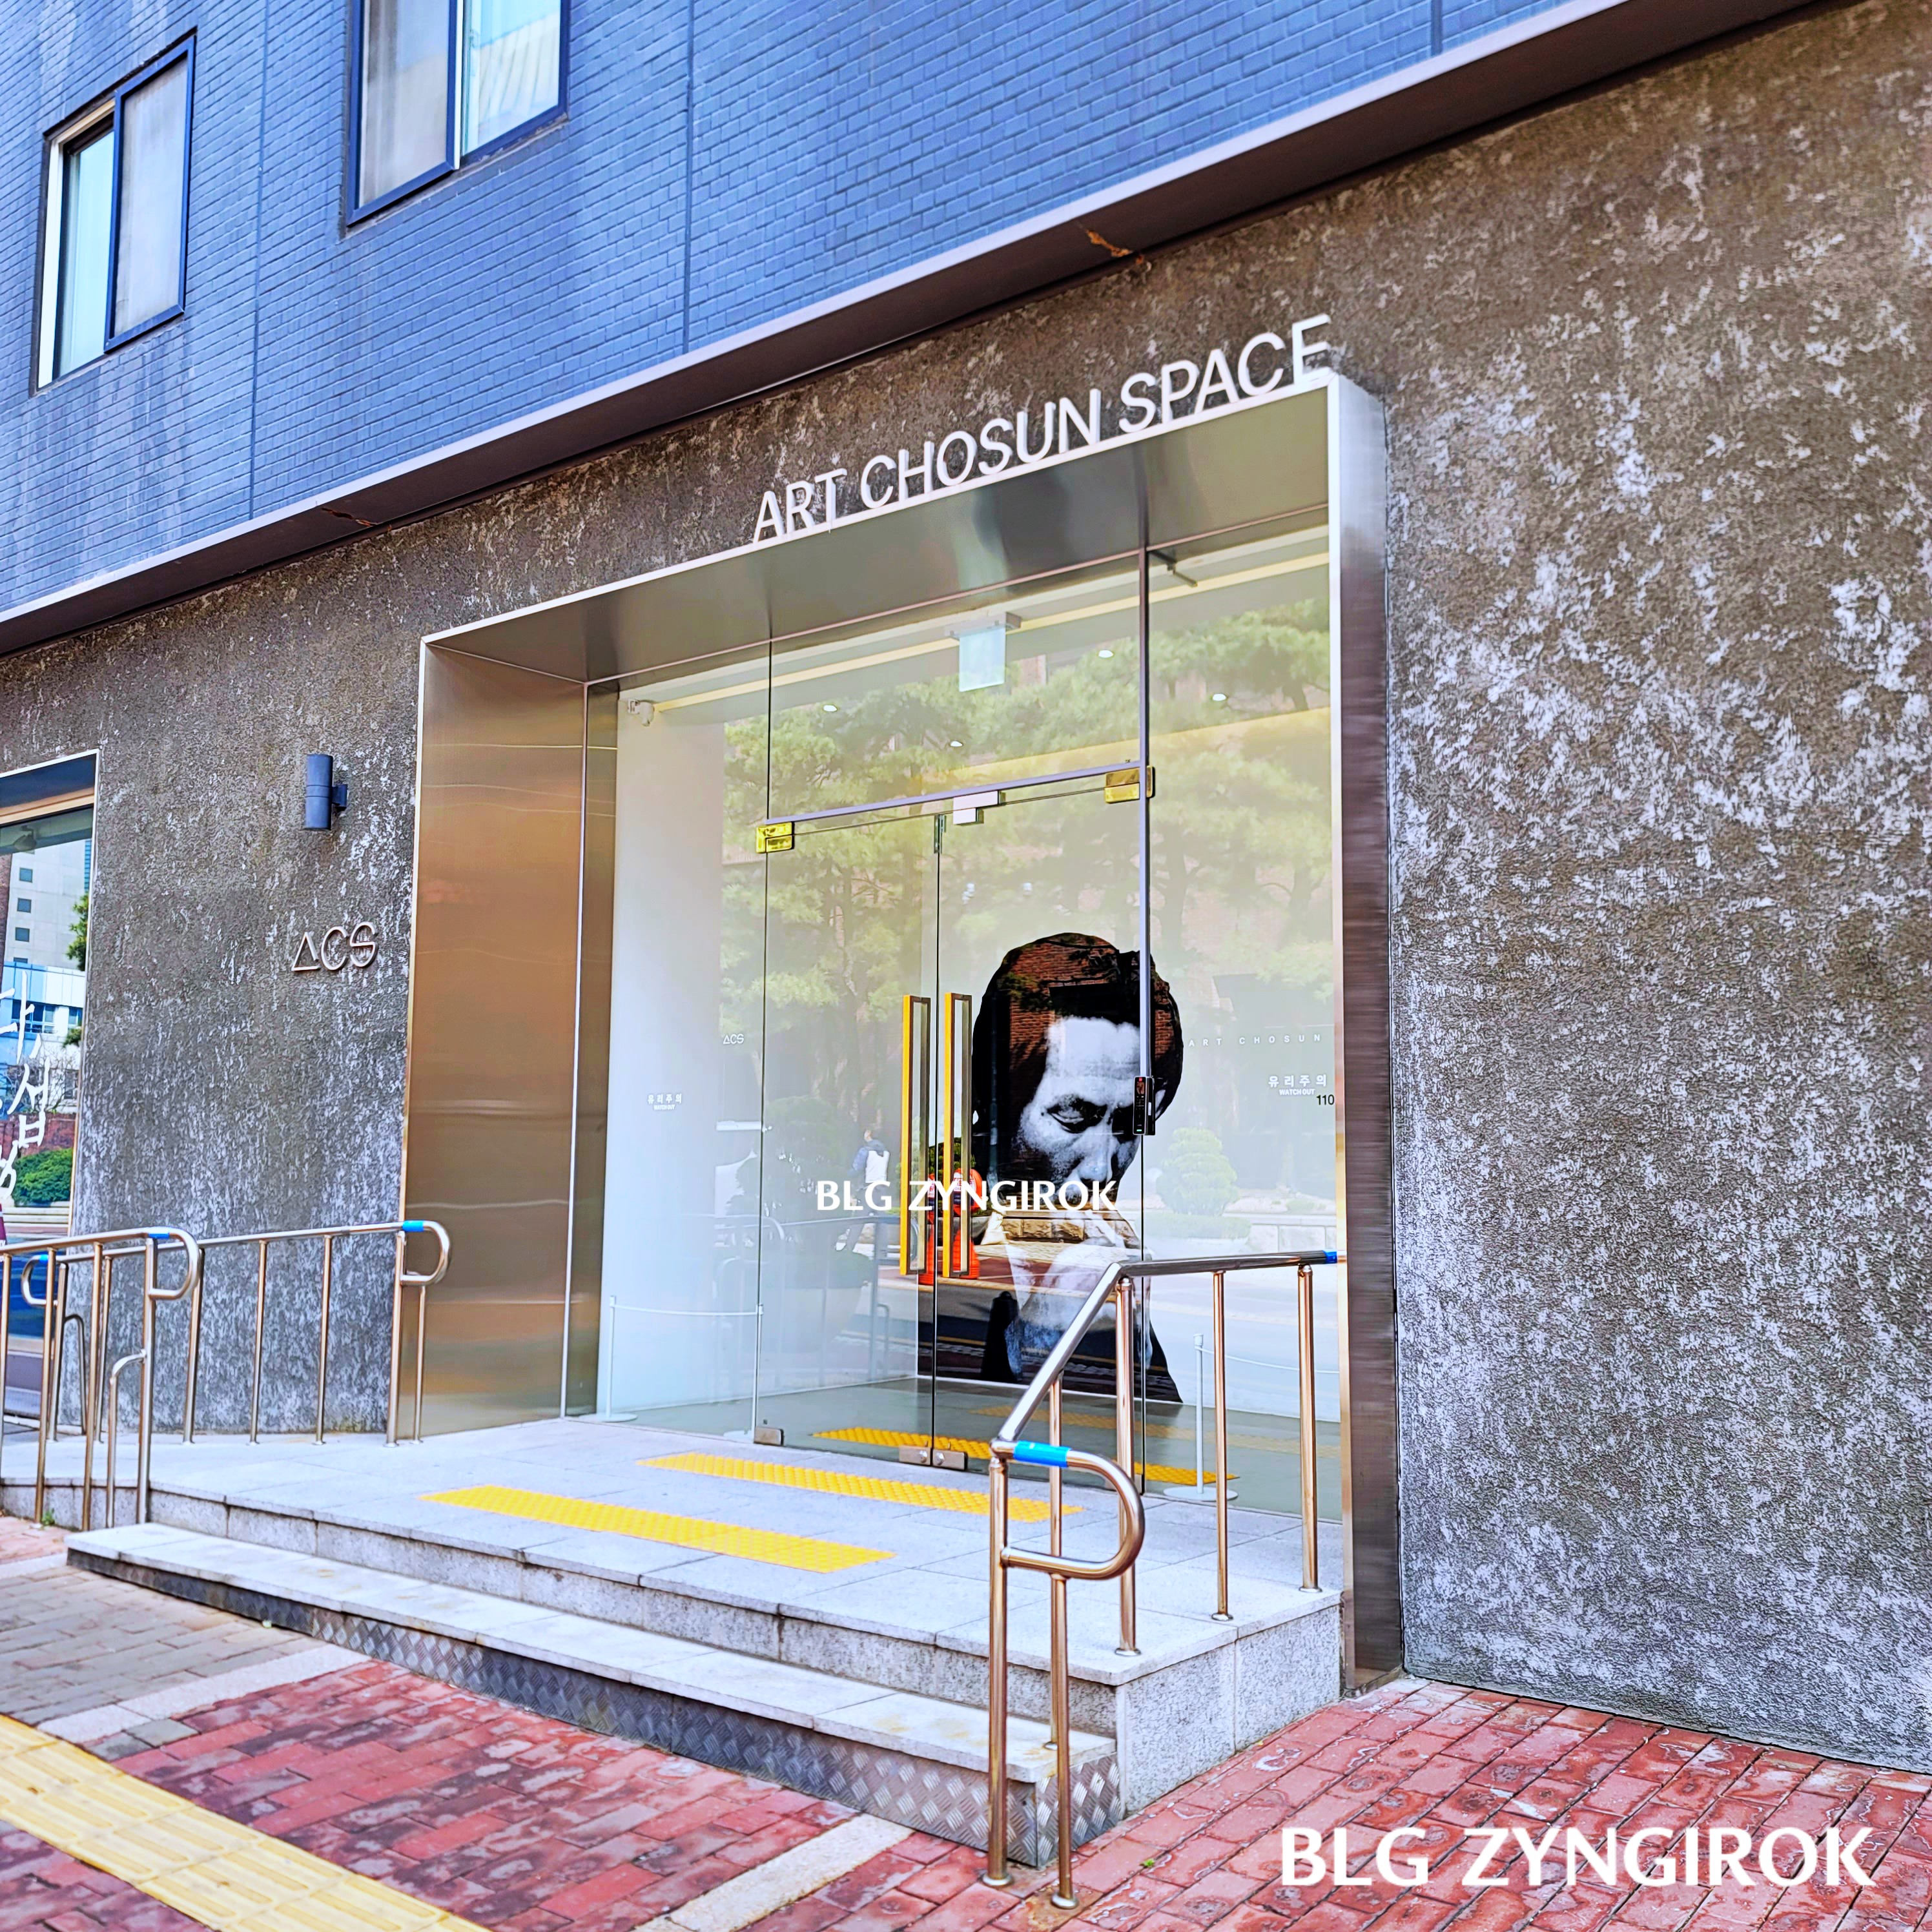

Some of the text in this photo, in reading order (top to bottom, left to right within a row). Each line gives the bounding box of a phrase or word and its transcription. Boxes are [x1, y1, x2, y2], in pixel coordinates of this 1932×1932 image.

[753, 313, 1332, 544] ART CHOSUN SPACE
[291, 921, 378, 972] ACS
[723, 1033, 744, 1045] ACS
[1189, 1034, 1321, 1047] ART CHOSUN
[1316, 1094, 1335, 1105] 110
